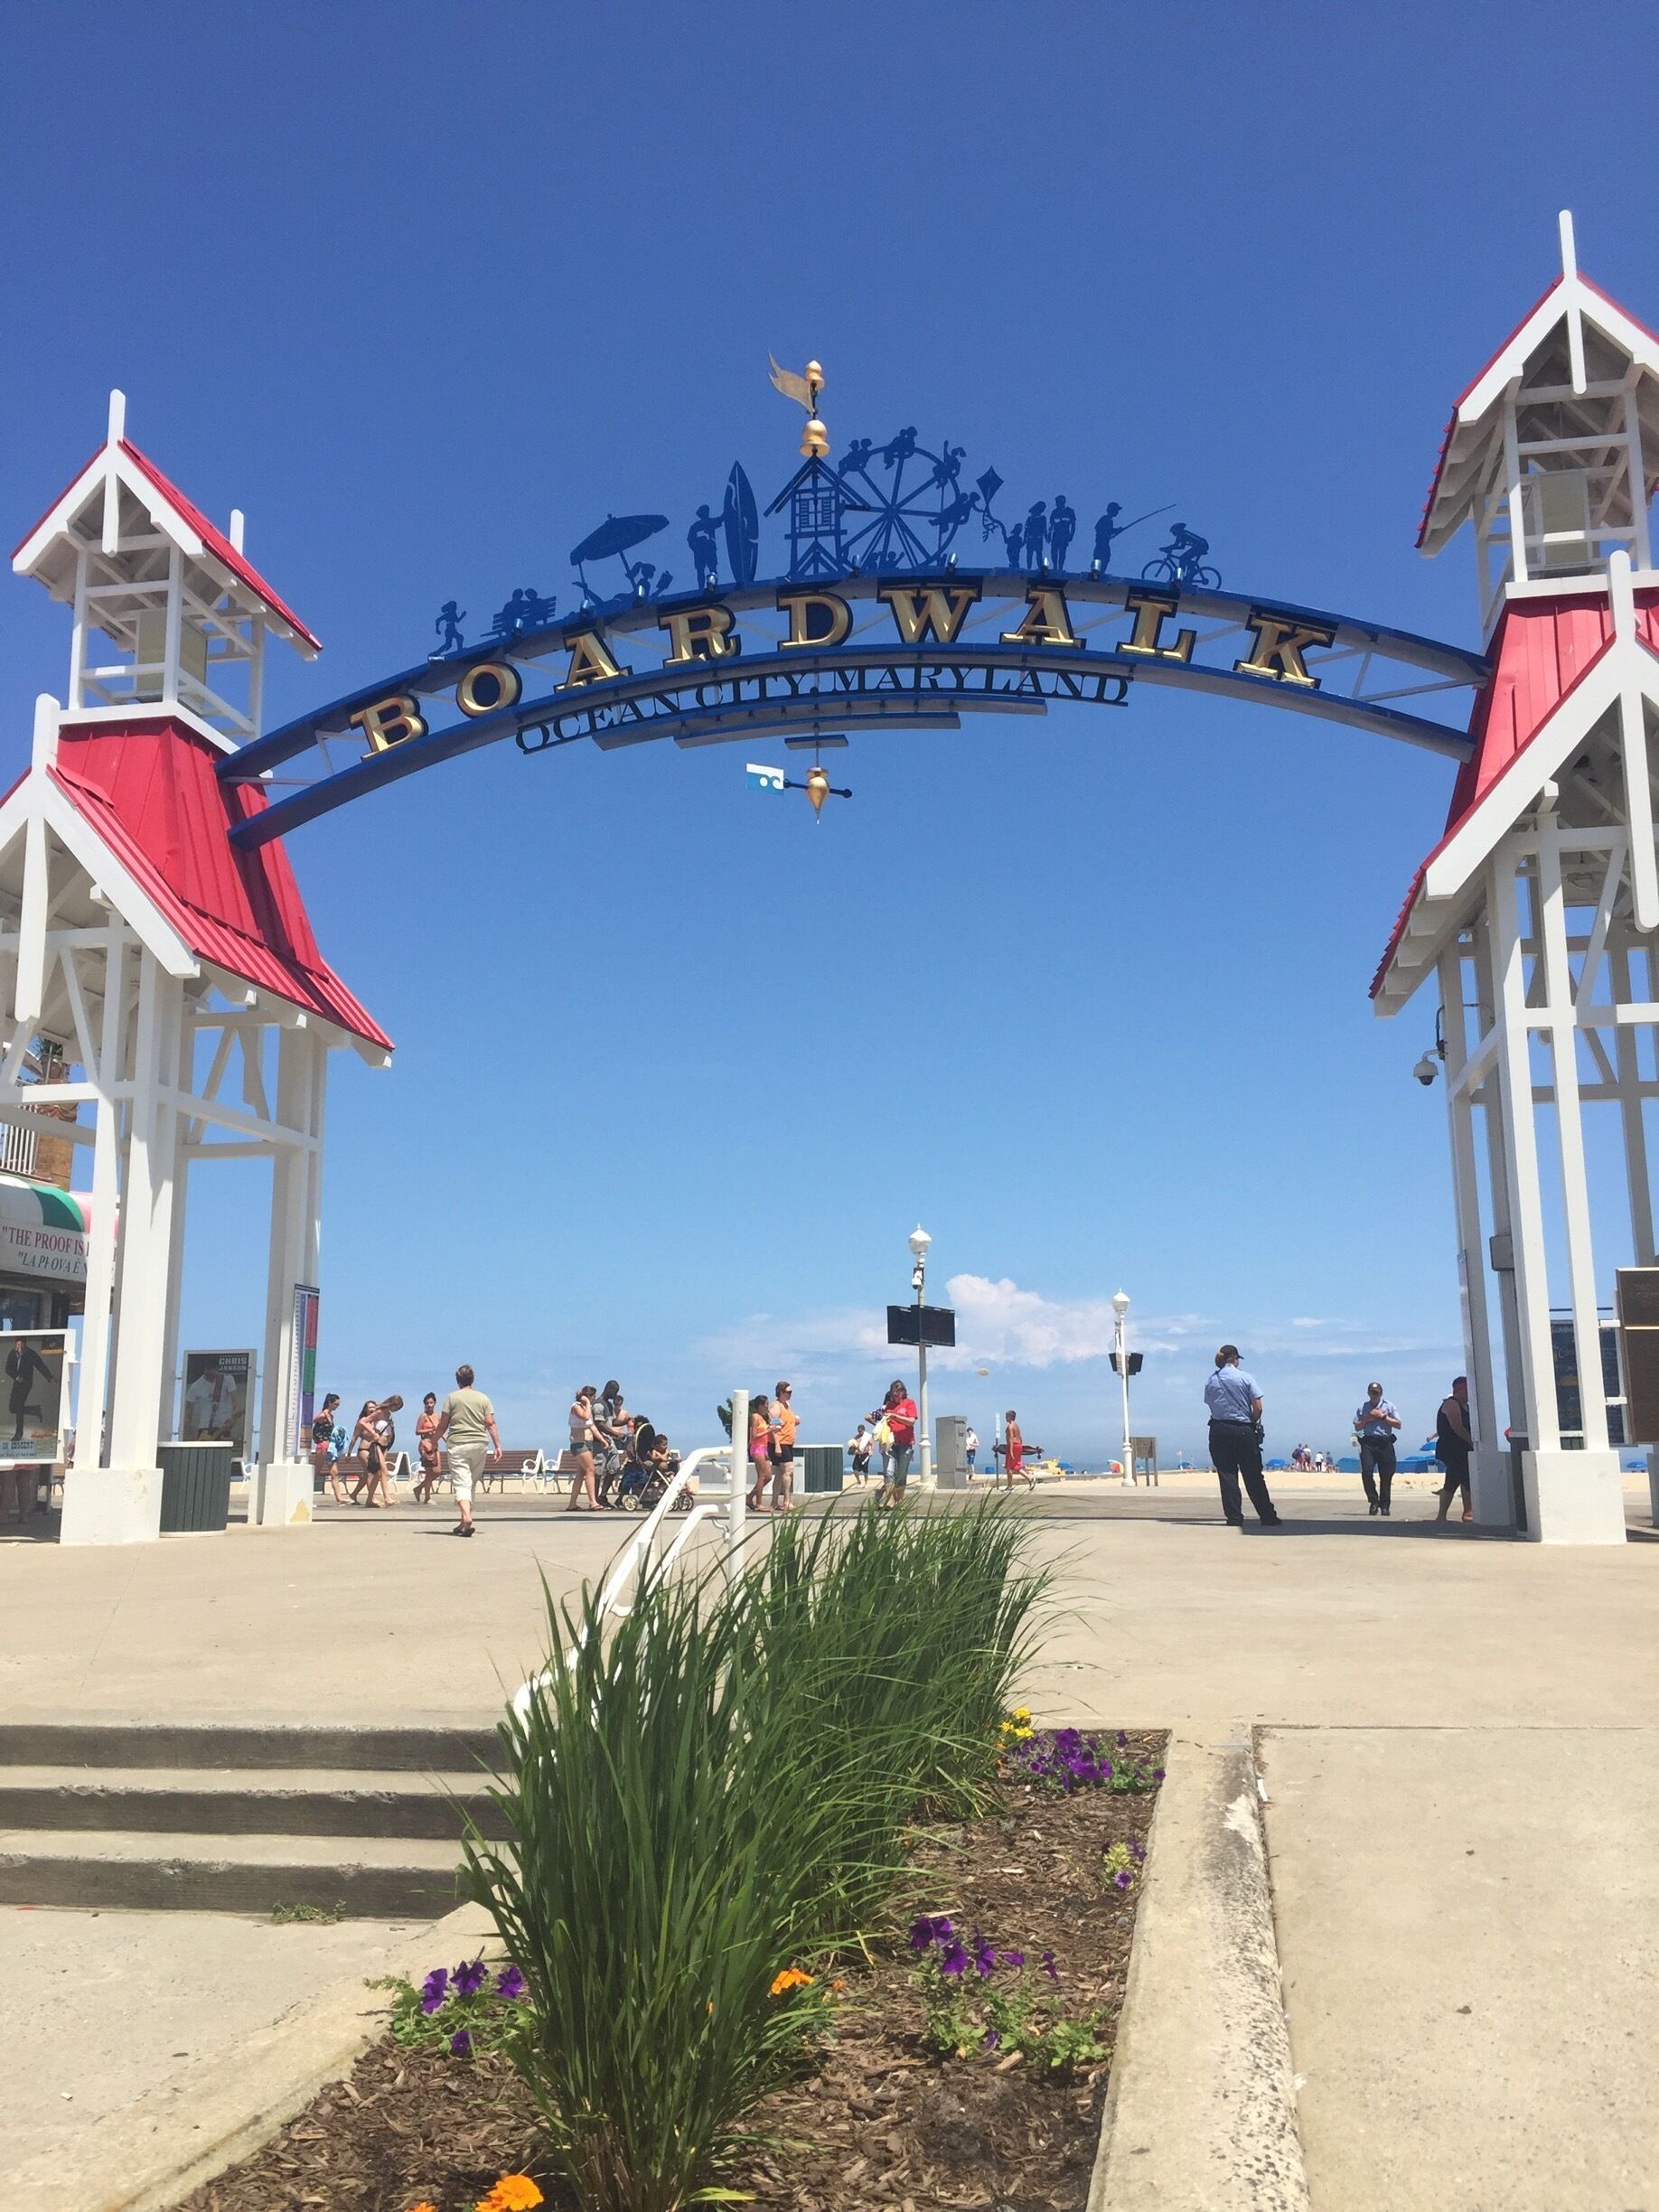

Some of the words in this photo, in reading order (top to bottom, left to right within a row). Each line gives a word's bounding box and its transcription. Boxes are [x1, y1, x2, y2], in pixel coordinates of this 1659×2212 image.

[351, 578, 1337, 761] BOARDWALK
[516, 691, 680, 755] OCEAN
[832, 665, 1128, 703] MARYLAND
[3, 1226, 32, 1247] "THE
[34, 1232, 72, 1253] PROOF
[74, 1240, 84, 1256] IS
[219, 1357, 247, 1365] CHRIS
